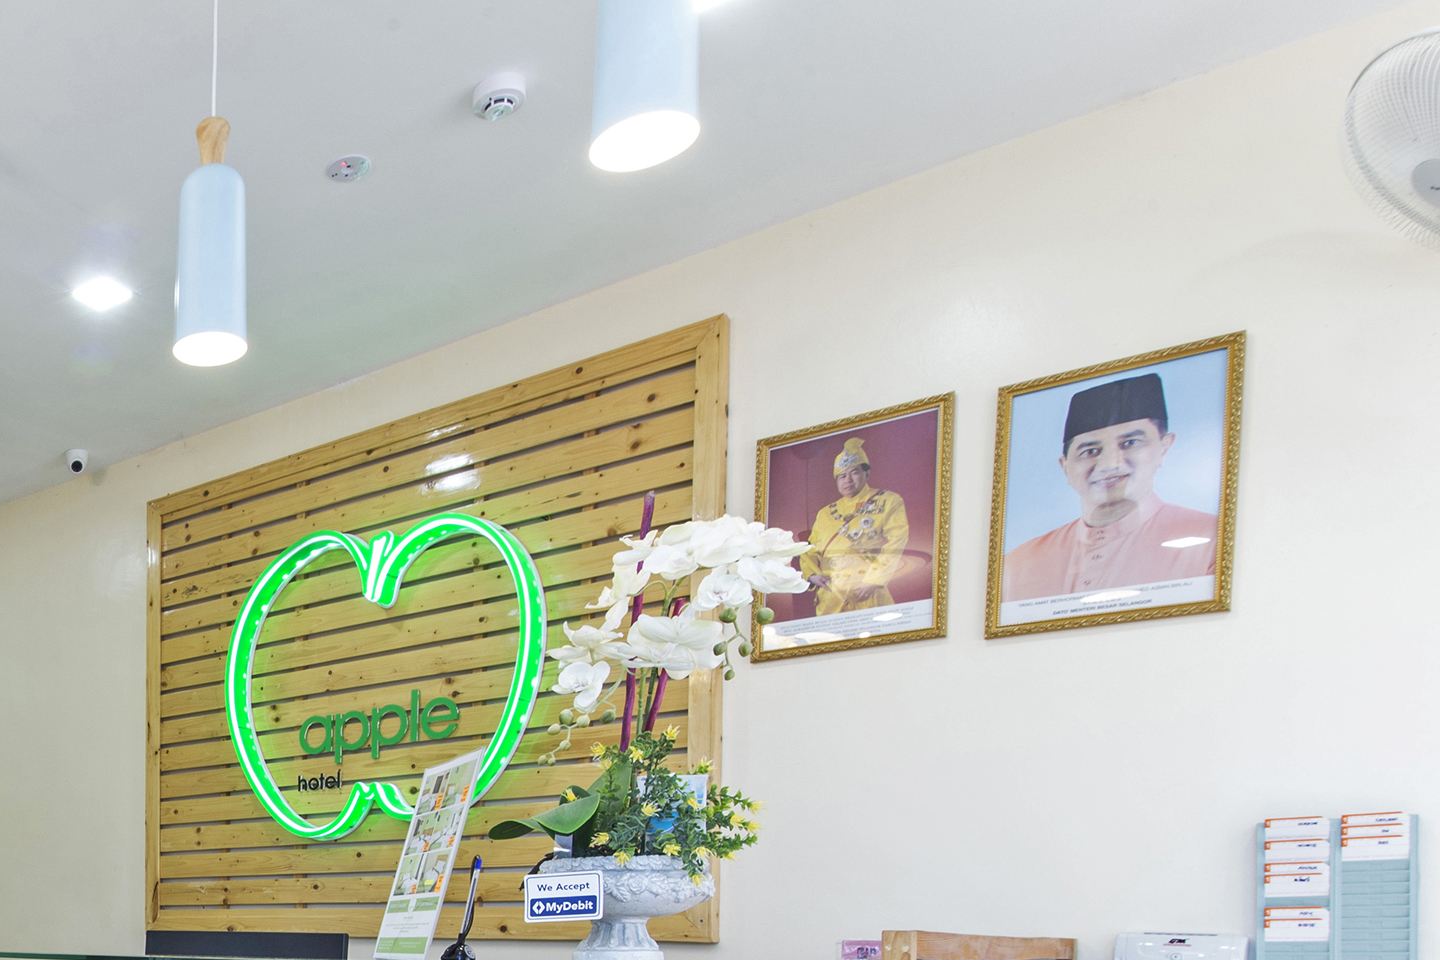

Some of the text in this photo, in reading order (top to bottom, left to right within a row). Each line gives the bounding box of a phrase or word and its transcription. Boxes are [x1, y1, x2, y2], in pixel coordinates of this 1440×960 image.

[1119, 599, 1152, 607] SELANGOR
[299, 689, 460, 764] apple
[298, 769, 342, 792] hotel
[537, 882, 590, 892] We Accept
[546, 900, 594, 914] MyDebit
